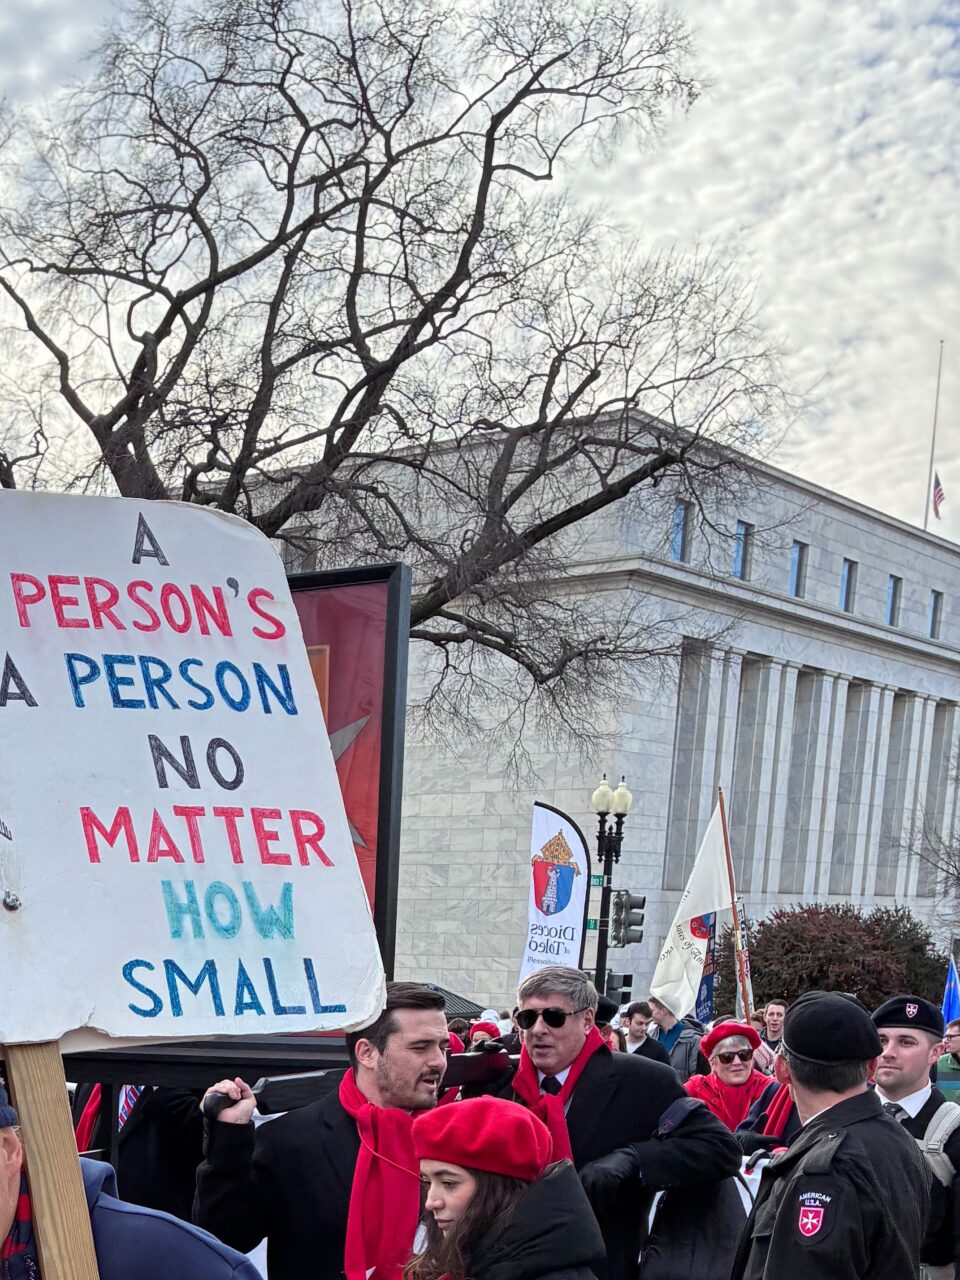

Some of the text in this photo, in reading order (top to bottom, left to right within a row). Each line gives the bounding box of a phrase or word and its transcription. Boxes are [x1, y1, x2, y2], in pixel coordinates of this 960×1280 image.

[133, 512, 170, 566] A
[8, 572, 288, 640] PERSON'S
[64, 652, 299, 715] PERSON
[147, 734, 246, 791] NO
[79, 805, 336, 867] MATTER
[160, 879, 295, 940] HOW
[122, 957, 347, 1018] SMALL
[800, 1192, 831, 1202] AMERICAN
